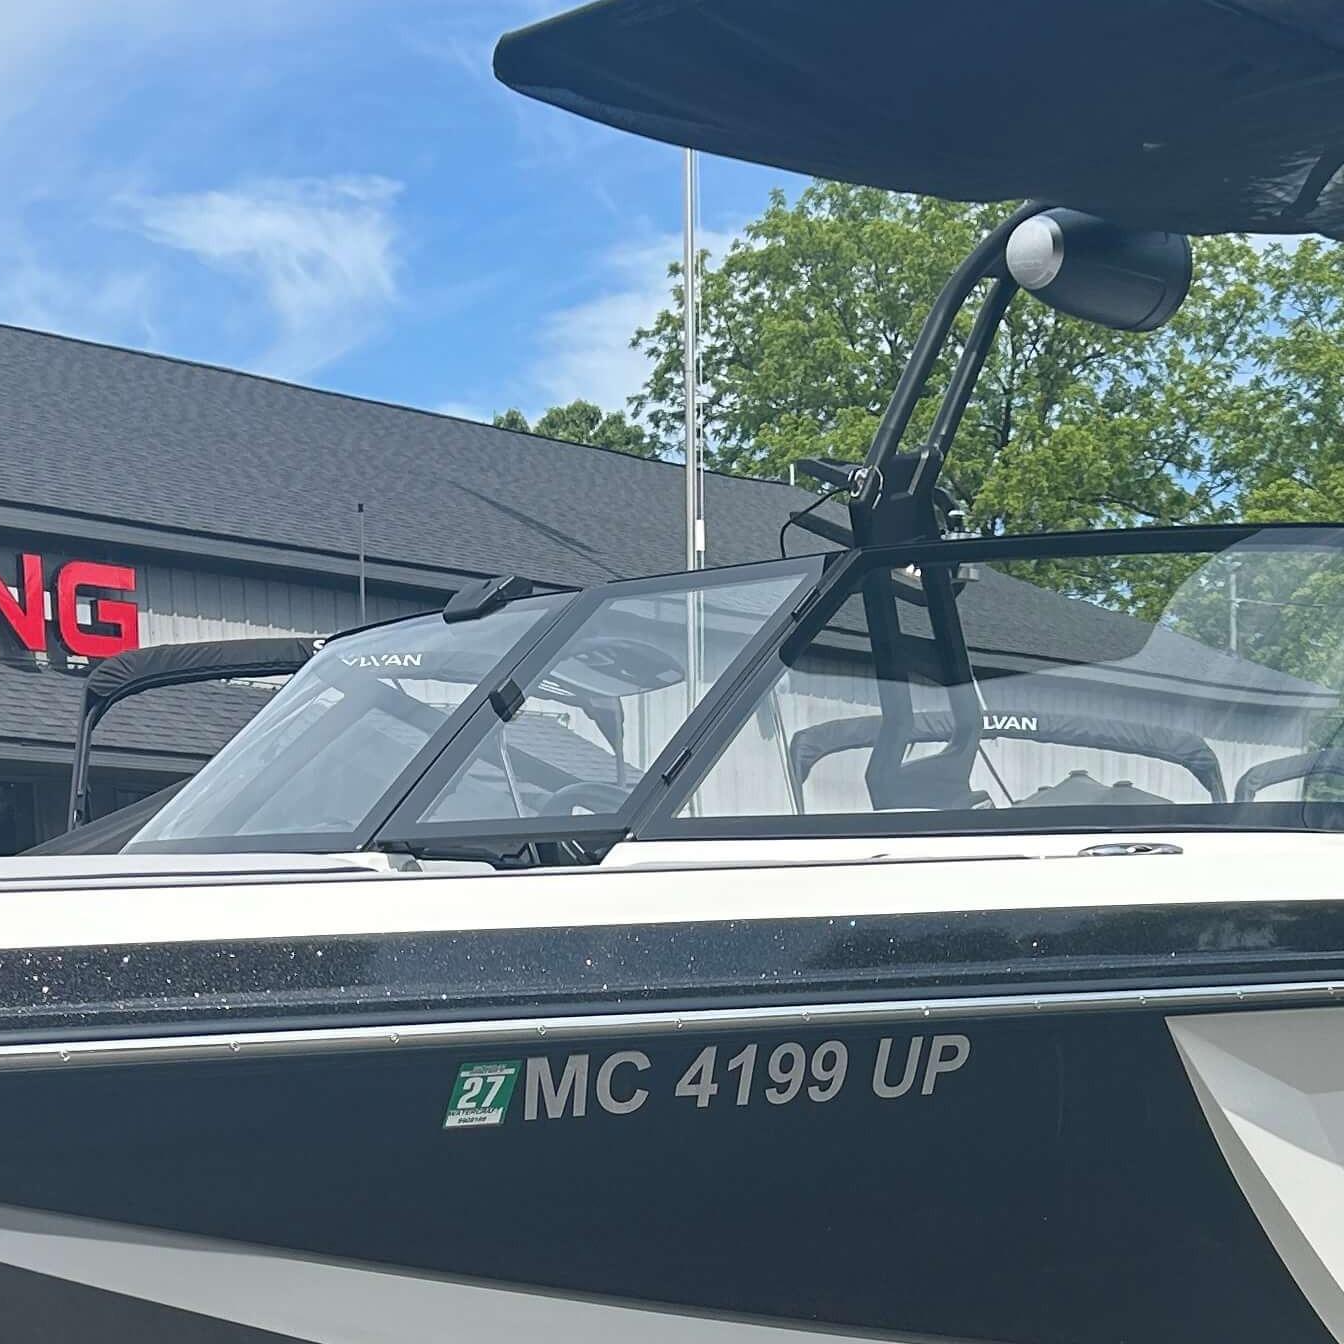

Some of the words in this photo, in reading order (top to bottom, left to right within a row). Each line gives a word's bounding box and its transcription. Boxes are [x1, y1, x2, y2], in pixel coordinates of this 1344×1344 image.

[456, 1075, 506, 1109] 27
[524, 1050, 652, 1120] MC
[675, 1040, 850, 1108] 4199
[872, 1034, 971, 1098] UP
